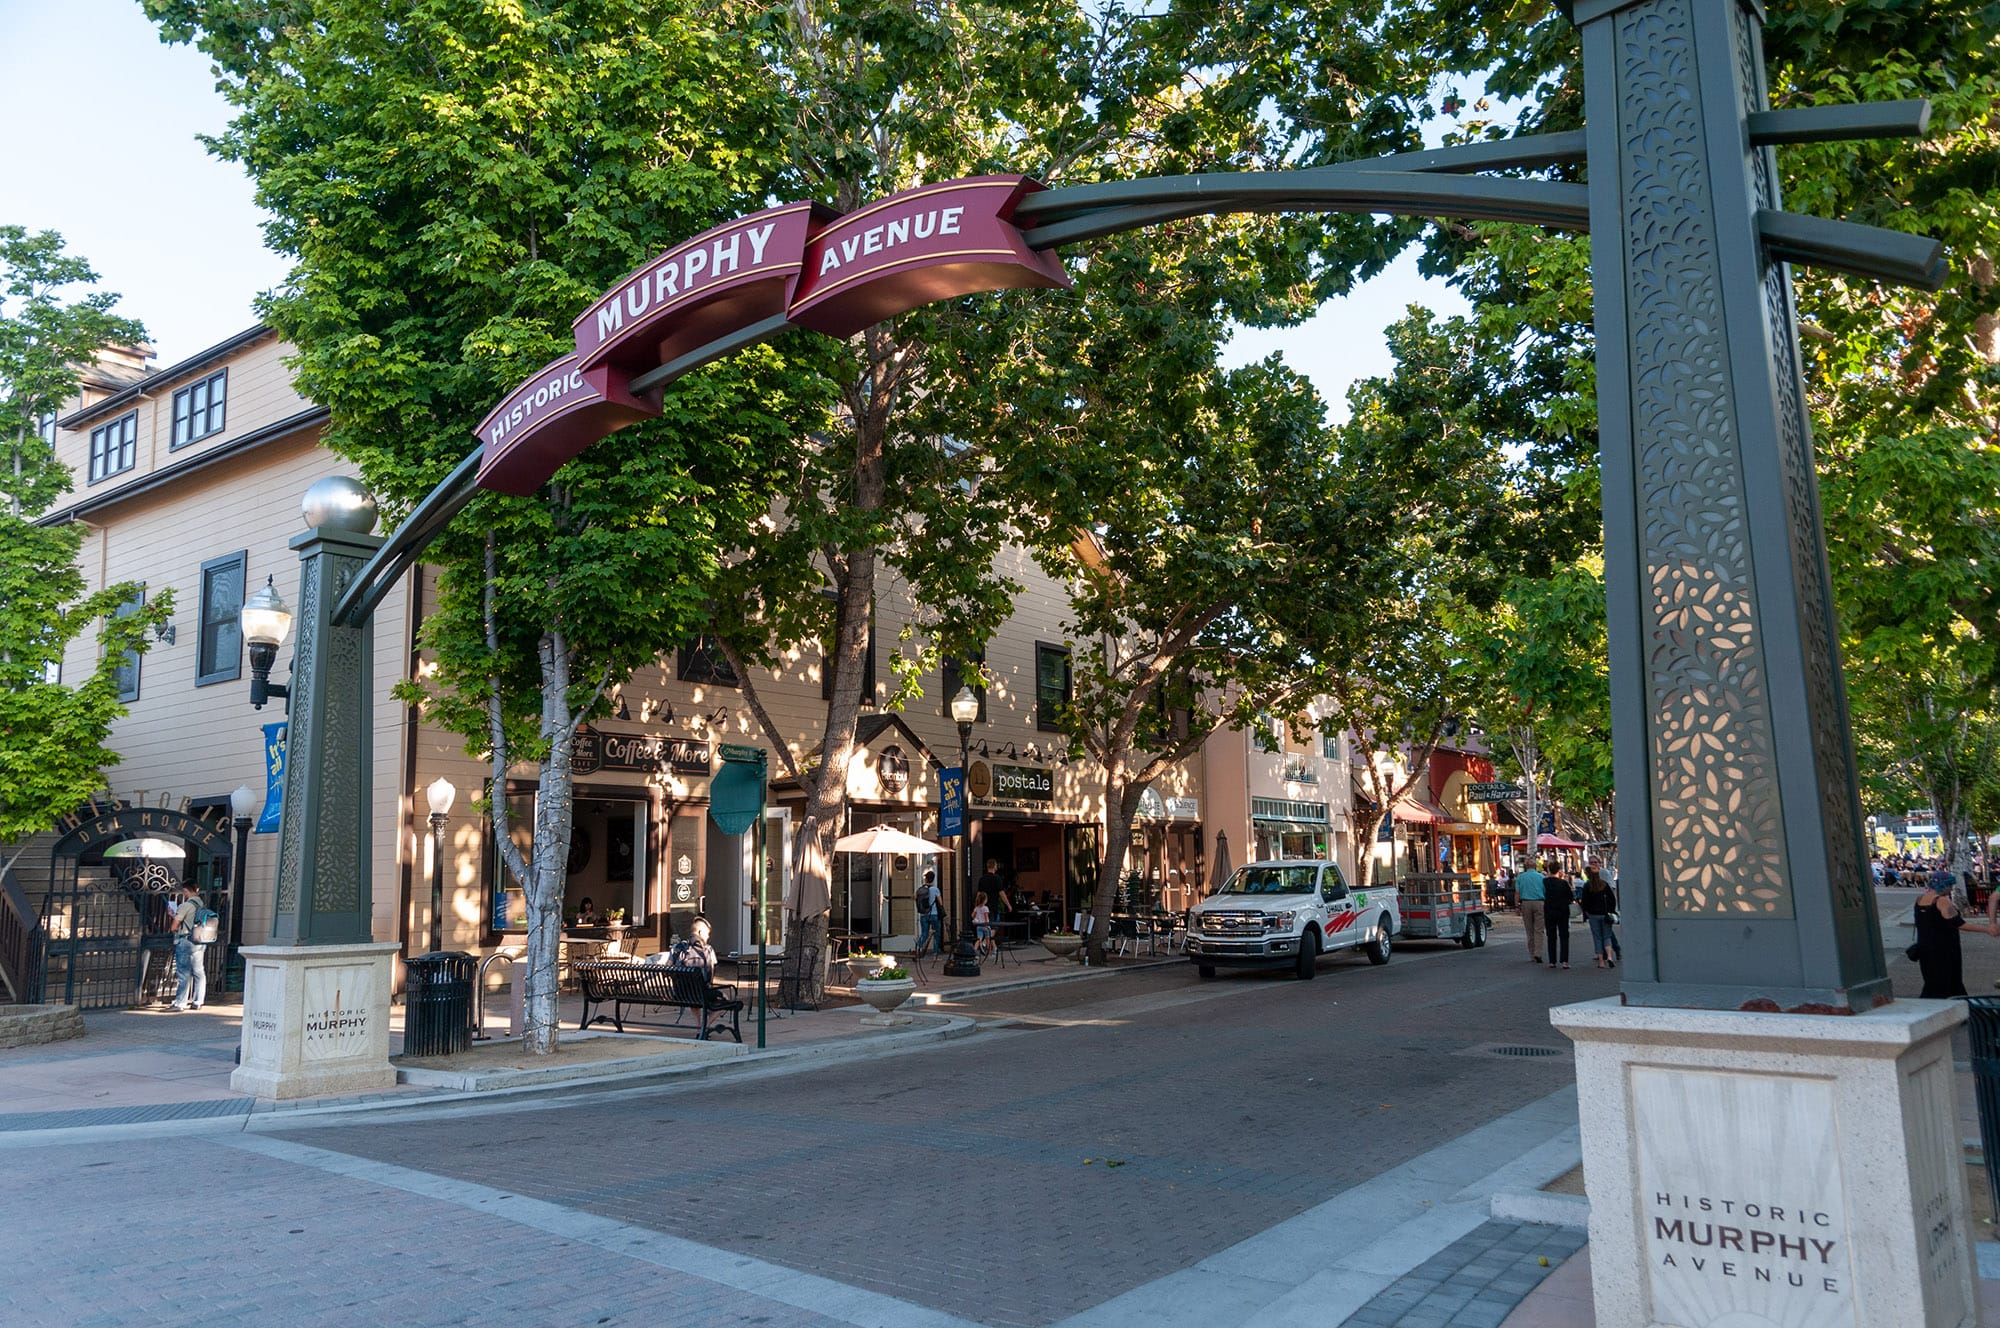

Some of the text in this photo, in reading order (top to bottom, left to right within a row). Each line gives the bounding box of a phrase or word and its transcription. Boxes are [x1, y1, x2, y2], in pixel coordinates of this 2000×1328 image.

[490, 206, 964, 446] HISTORIC MURPHY AVENUE
[571, 737, 592, 749] Coffee
[605, 738, 652, 765] Coffee
[670, 743, 709, 763] More
[999, 774, 1050, 791] postale
[944, 787, 956, 800] all
[1468, 791, 1486, 800] Paul
[63, 790, 231, 833] HISTORIC
[78, 813, 216, 845] DEL MONTE
[308, 1008, 366, 1019] HISTORIC
[253, 1020, 277, 1032] MURPHY
[306, 1018, 367, 1032] MURPHY
[307, 1030, 366, 1041] AVENUE
[1656, 1192, 1831, 1227] HISTORIC
[1655, 1216, 1836, 1265] MURPHY
[1663, 1253, 1839, 1294] AVENUE
